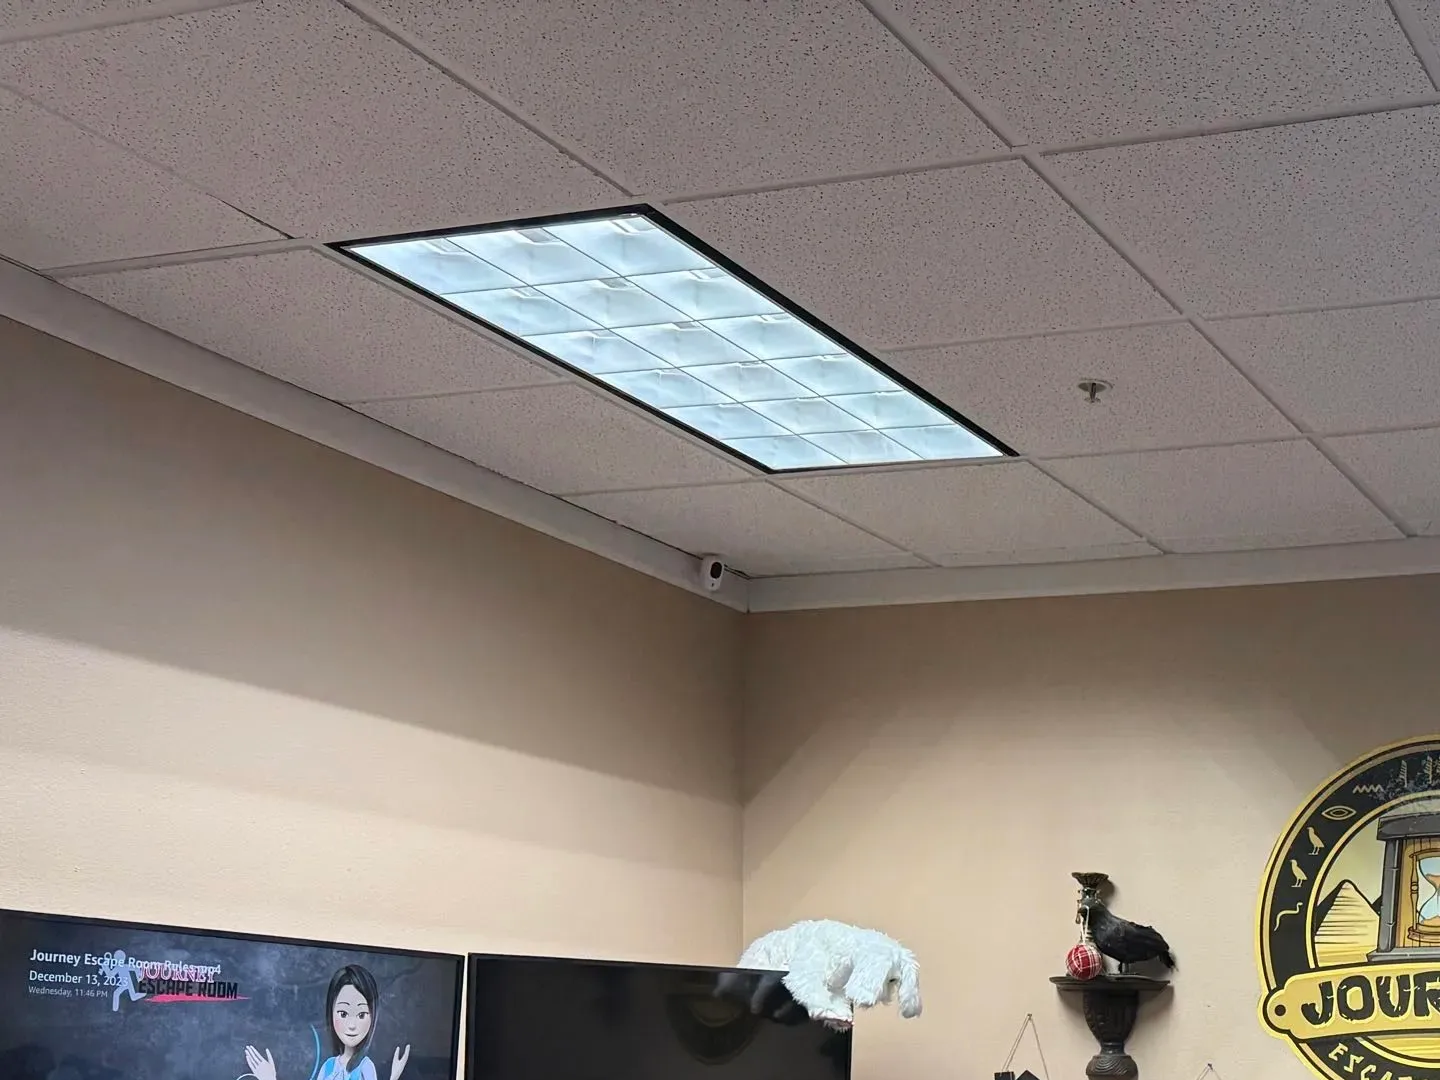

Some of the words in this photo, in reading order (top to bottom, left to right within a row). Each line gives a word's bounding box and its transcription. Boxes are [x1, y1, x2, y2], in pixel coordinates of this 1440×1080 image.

[30, 949, 81, 967] Journey
[84, 953, 125, 969] Escape
[128, 957, 161, 970] Room
[29, 970, 82, 983] December
[86, 974, 101, 987] 13,
[103, 975, 129, 987] 2023
[28, 985, 73, 998] Wednesday,
[75, 988, 95, 997] 11:46
[96, 990, 108, 998] PM
